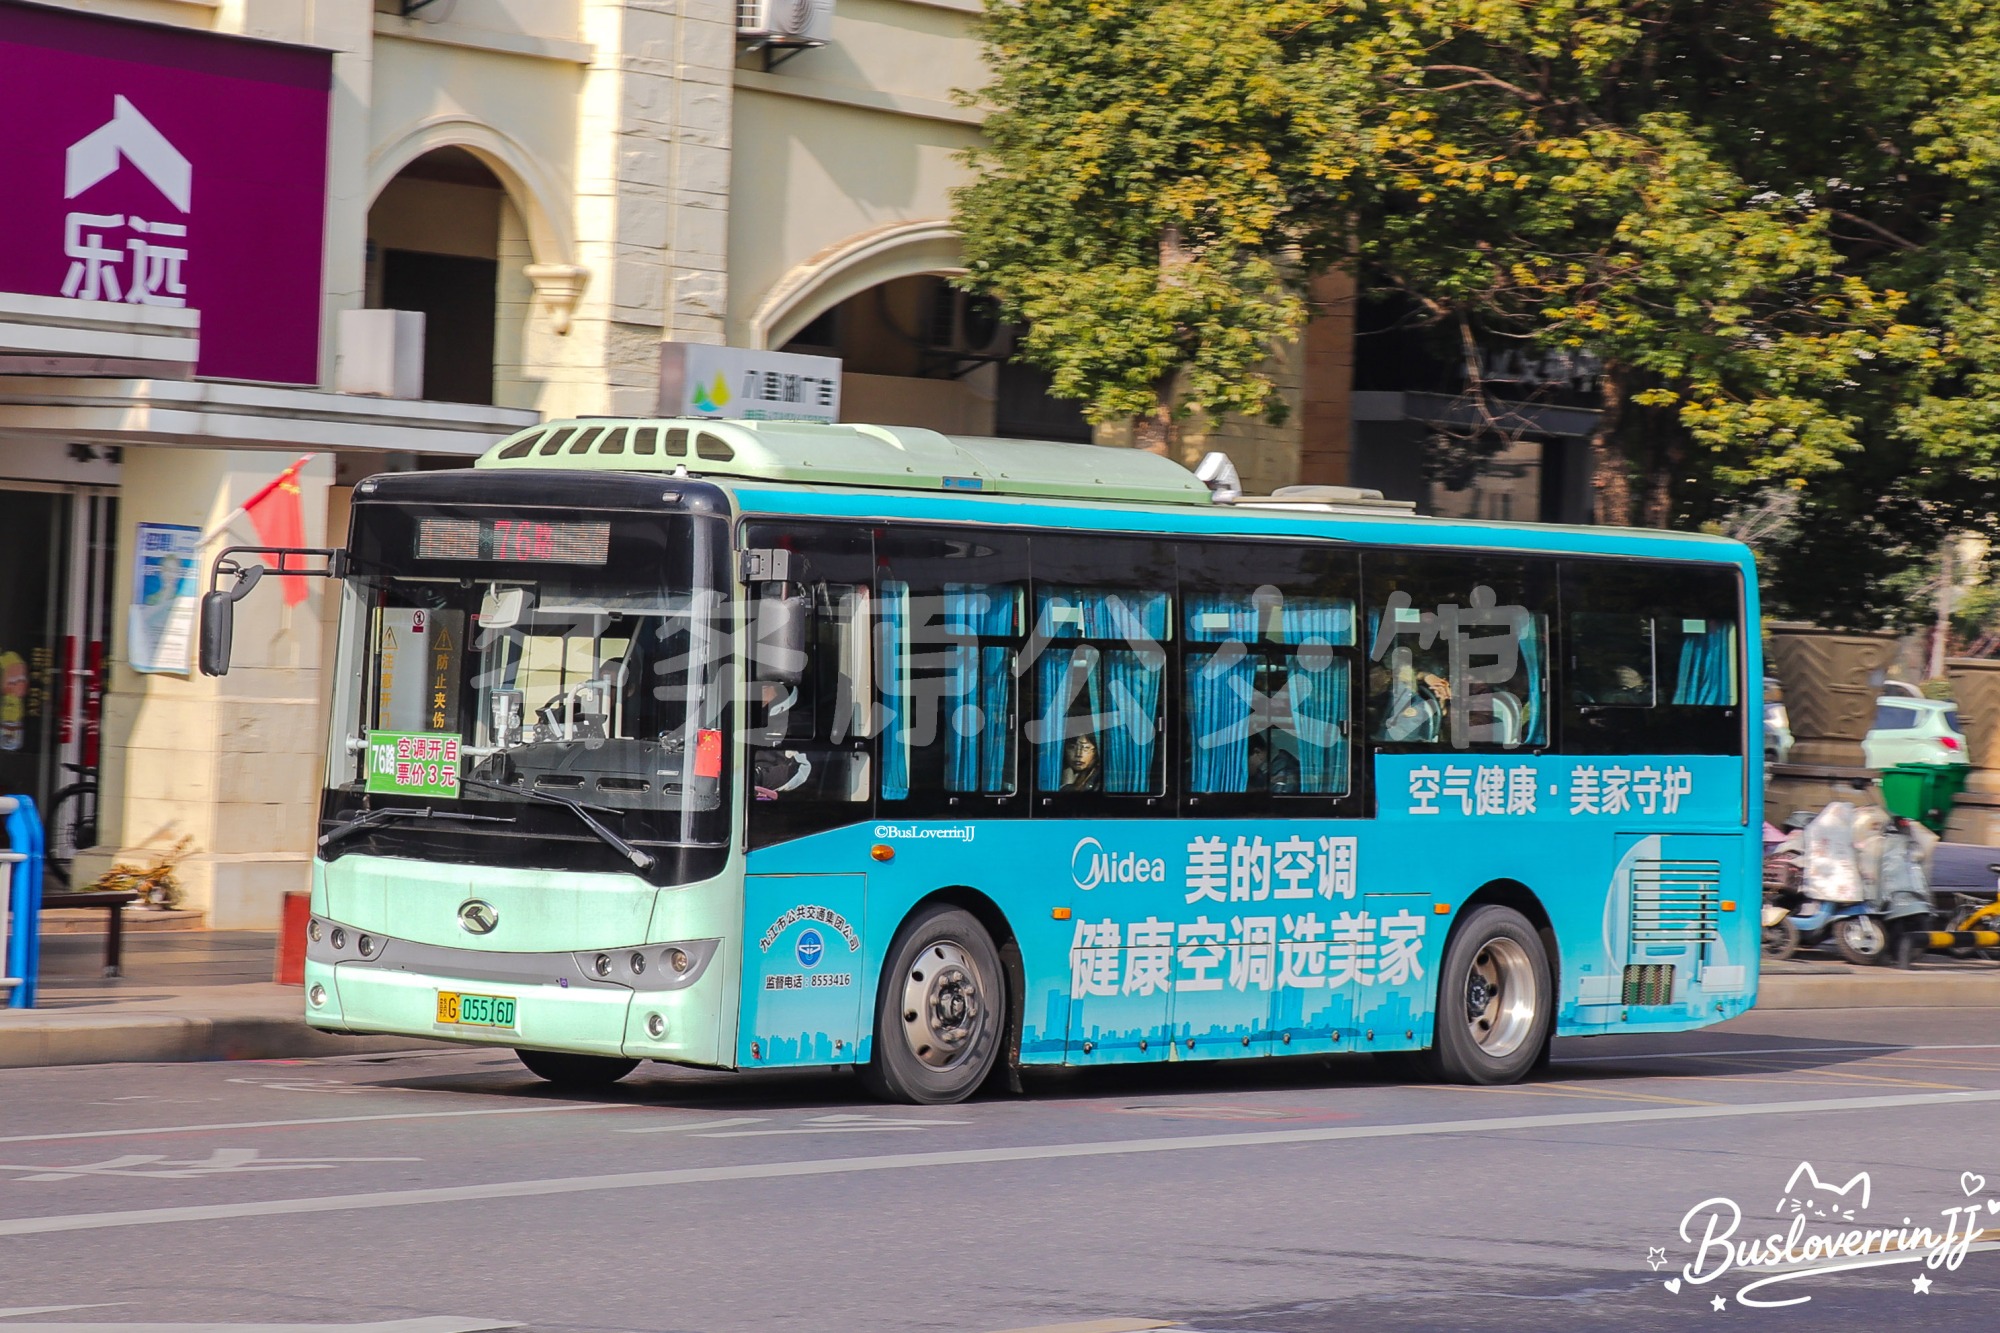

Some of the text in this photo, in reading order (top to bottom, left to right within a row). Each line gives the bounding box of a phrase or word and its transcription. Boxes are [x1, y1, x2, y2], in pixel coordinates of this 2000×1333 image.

[60, 211, 189, 308] 乐远
[379, 654, 394, 728] 注意开门
[432, 654, 449, 729] 防止夹伤
[372, 744, 395, 775] 76路
[396, 763, 456, 787] 票价3元
[397, 738, 458, 762] 空调开启
[1074, 835, 1358, 904] Midea 美的空调
[759, 904, 861, 953] 九江市公共交通集团公司
[1069, 909, 1426, 999] 健康空调选美家
